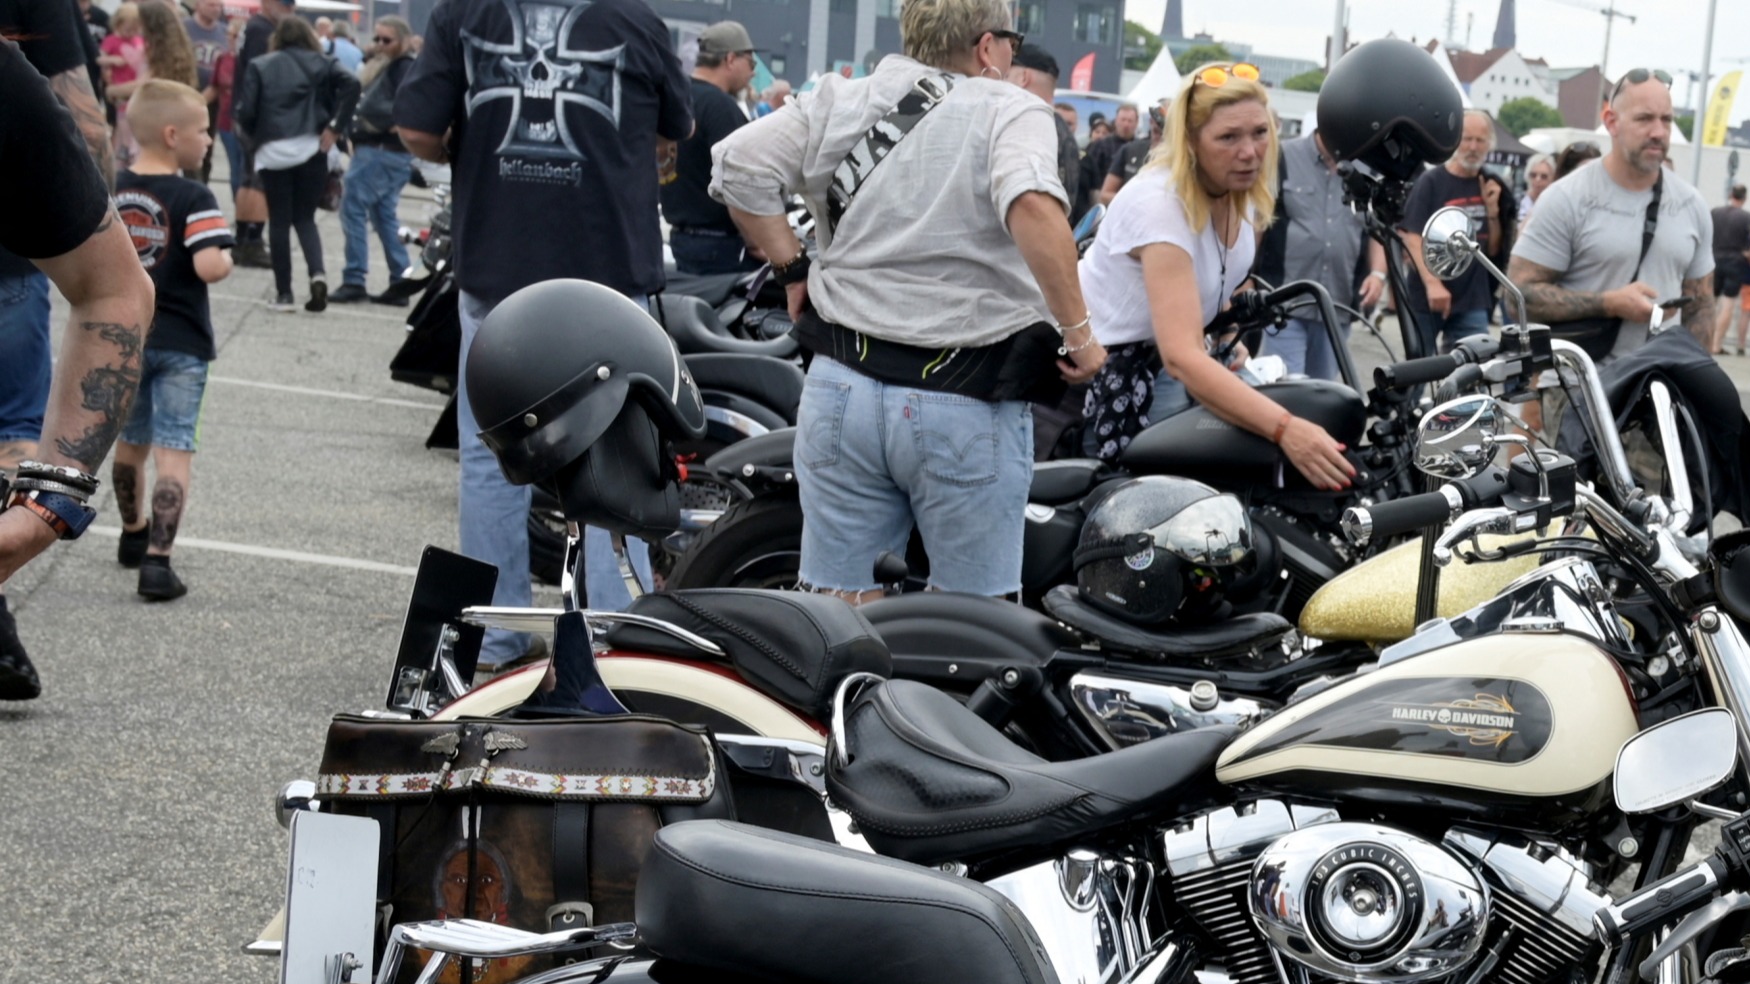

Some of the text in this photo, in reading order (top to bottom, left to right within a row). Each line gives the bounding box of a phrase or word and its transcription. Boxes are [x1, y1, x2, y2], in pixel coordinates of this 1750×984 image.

[1392, 707, 1514, 728] HARLEY DAVIDSON
[1312, 848, 1418, 898] 103 CUBIC INCHES
